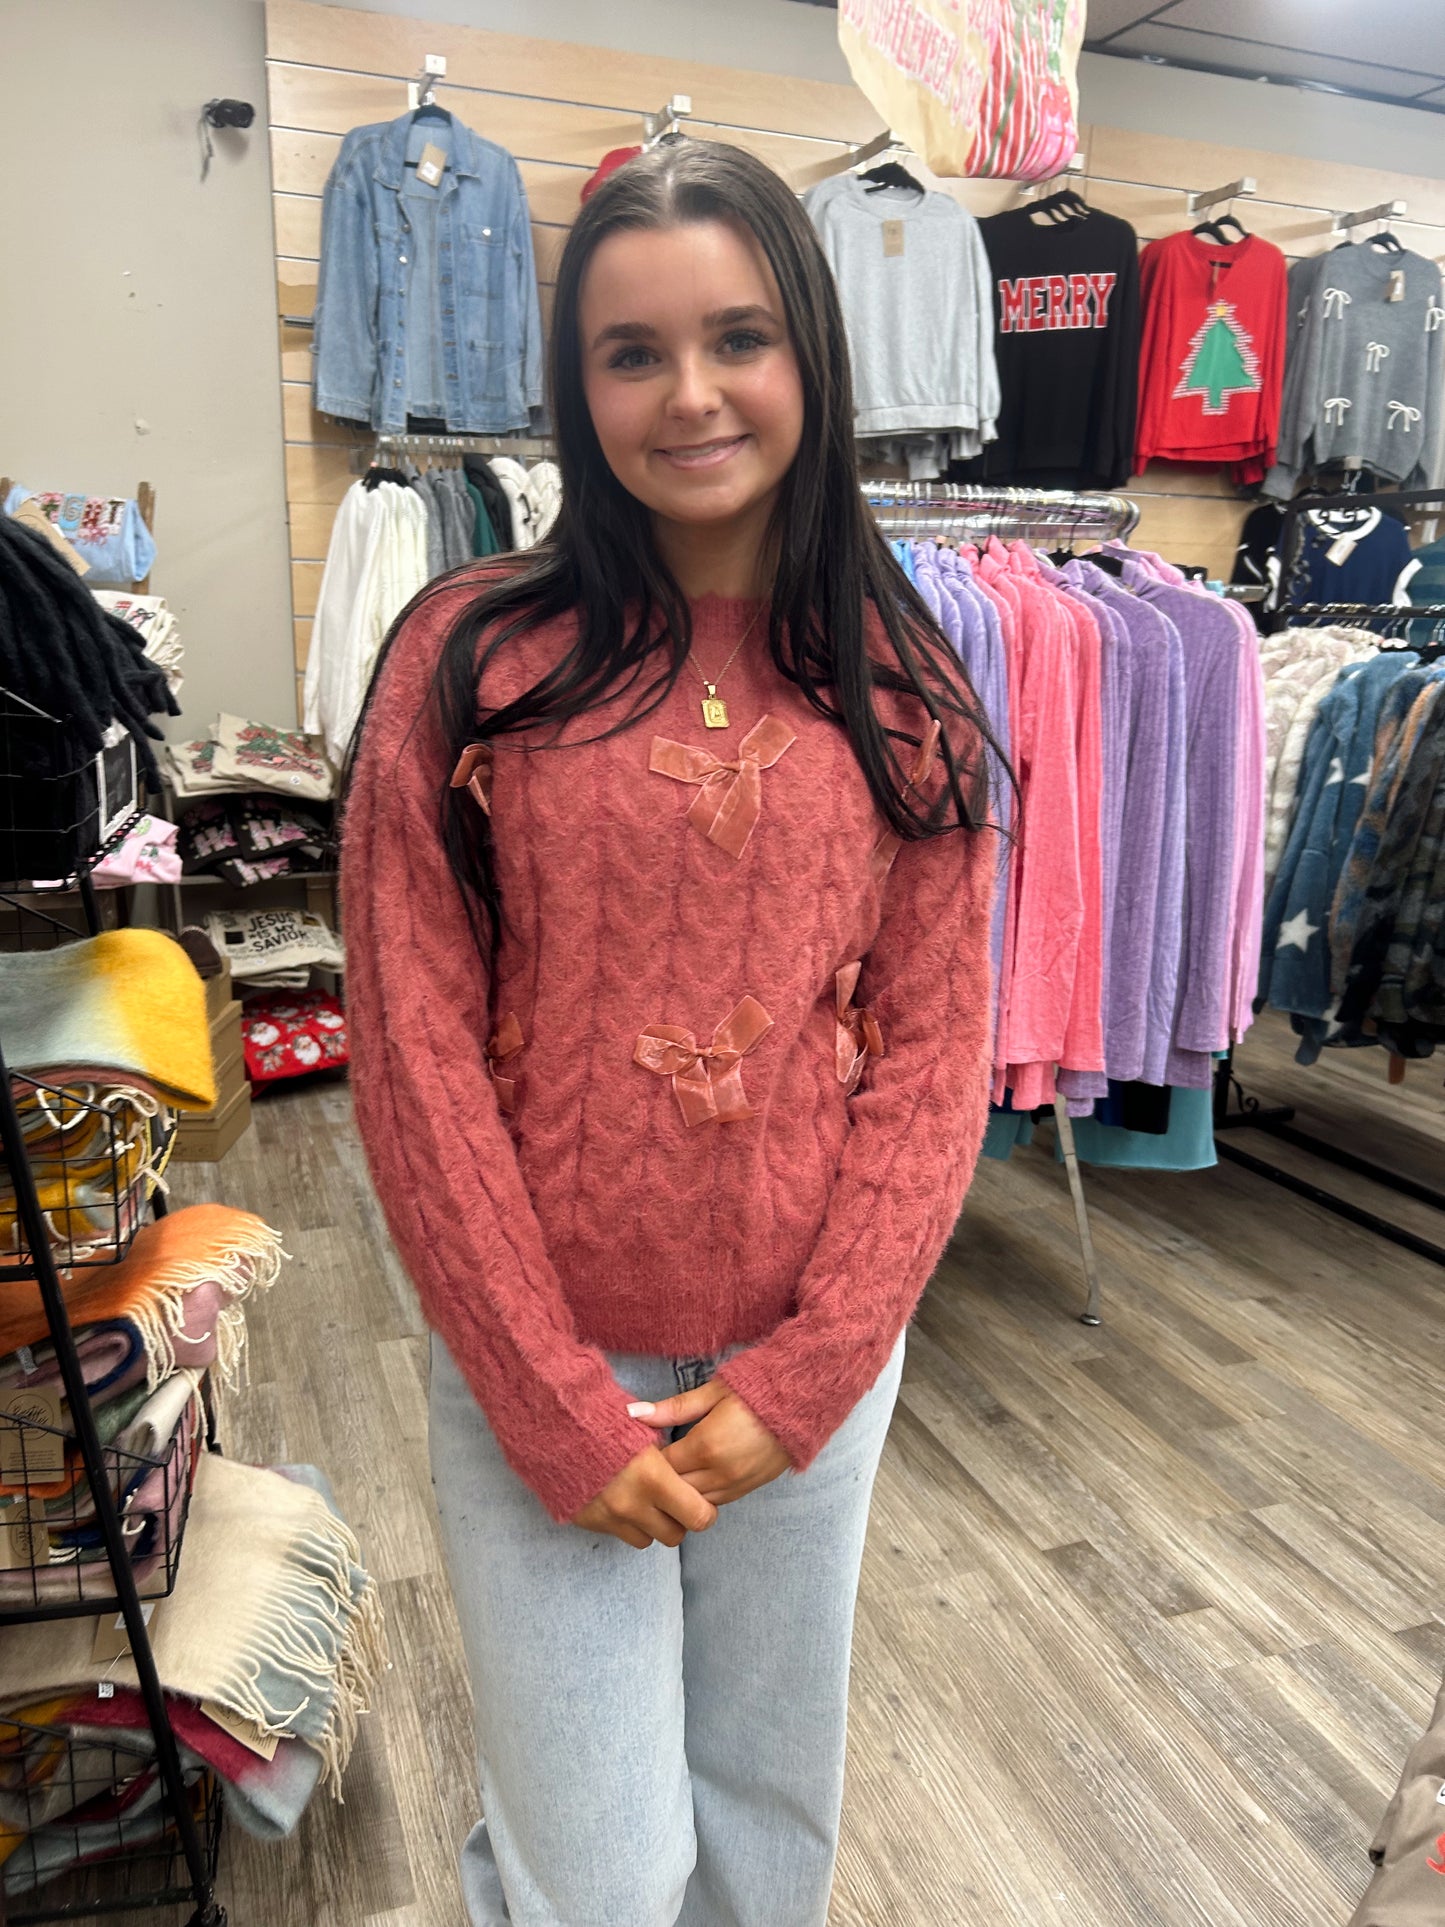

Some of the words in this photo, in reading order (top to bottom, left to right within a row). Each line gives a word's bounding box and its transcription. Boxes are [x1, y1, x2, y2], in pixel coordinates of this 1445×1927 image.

[998, 272, 1117, 333] MERRY
[248, 911, 297, 933] JESUS
[257, 929, 272, 940] IS
[274, 923, 295, 934] MY
